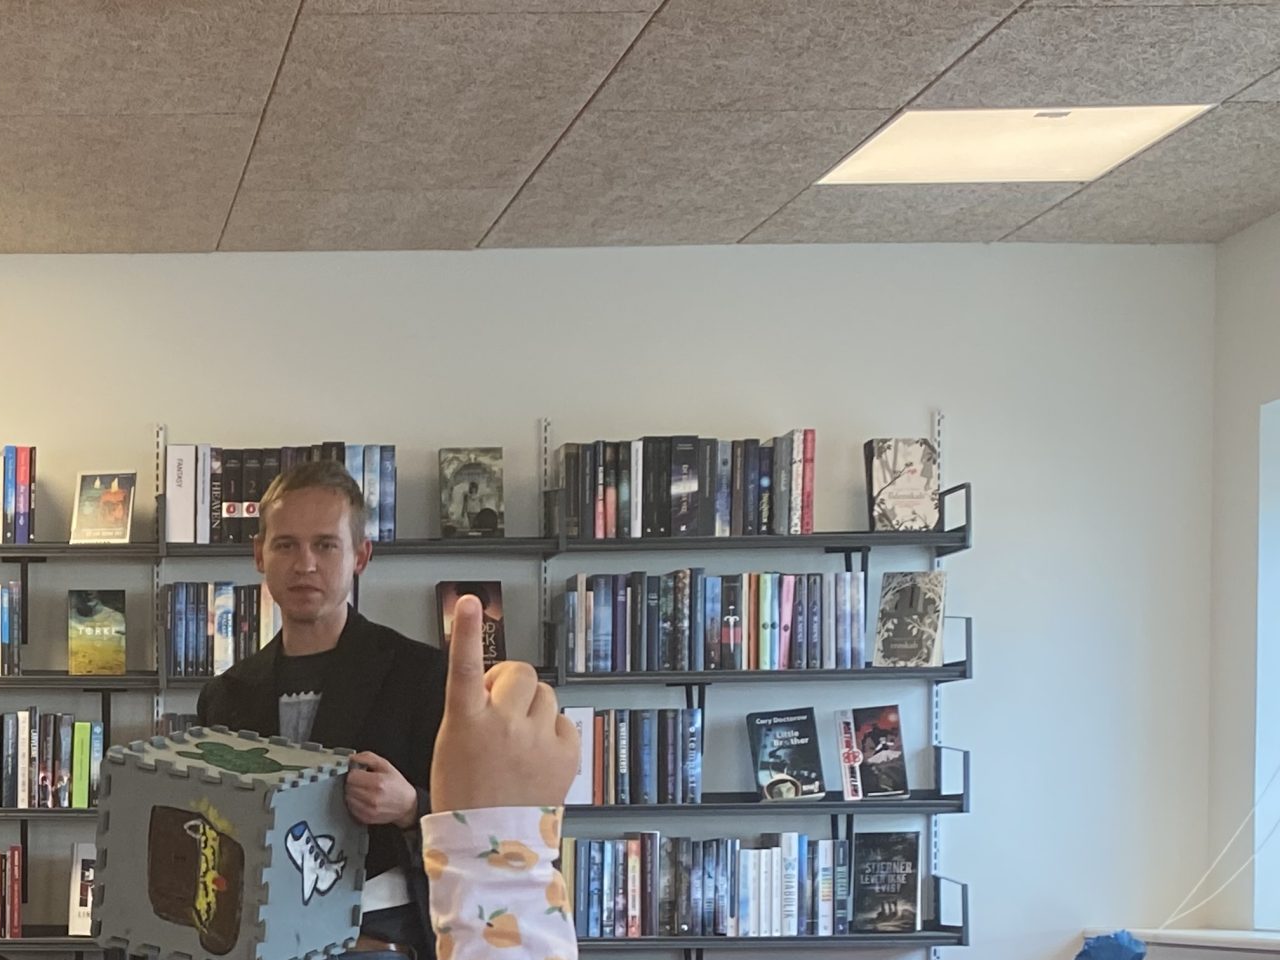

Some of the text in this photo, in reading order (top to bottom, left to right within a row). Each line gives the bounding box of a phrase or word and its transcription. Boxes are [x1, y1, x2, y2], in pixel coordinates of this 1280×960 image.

[176, 458, 184, 488] FANTASY
[211, 481, 221, 528] HEAVEN
[773, 737, 809, 746] Brother
[776, 730, 800, 739] Little
